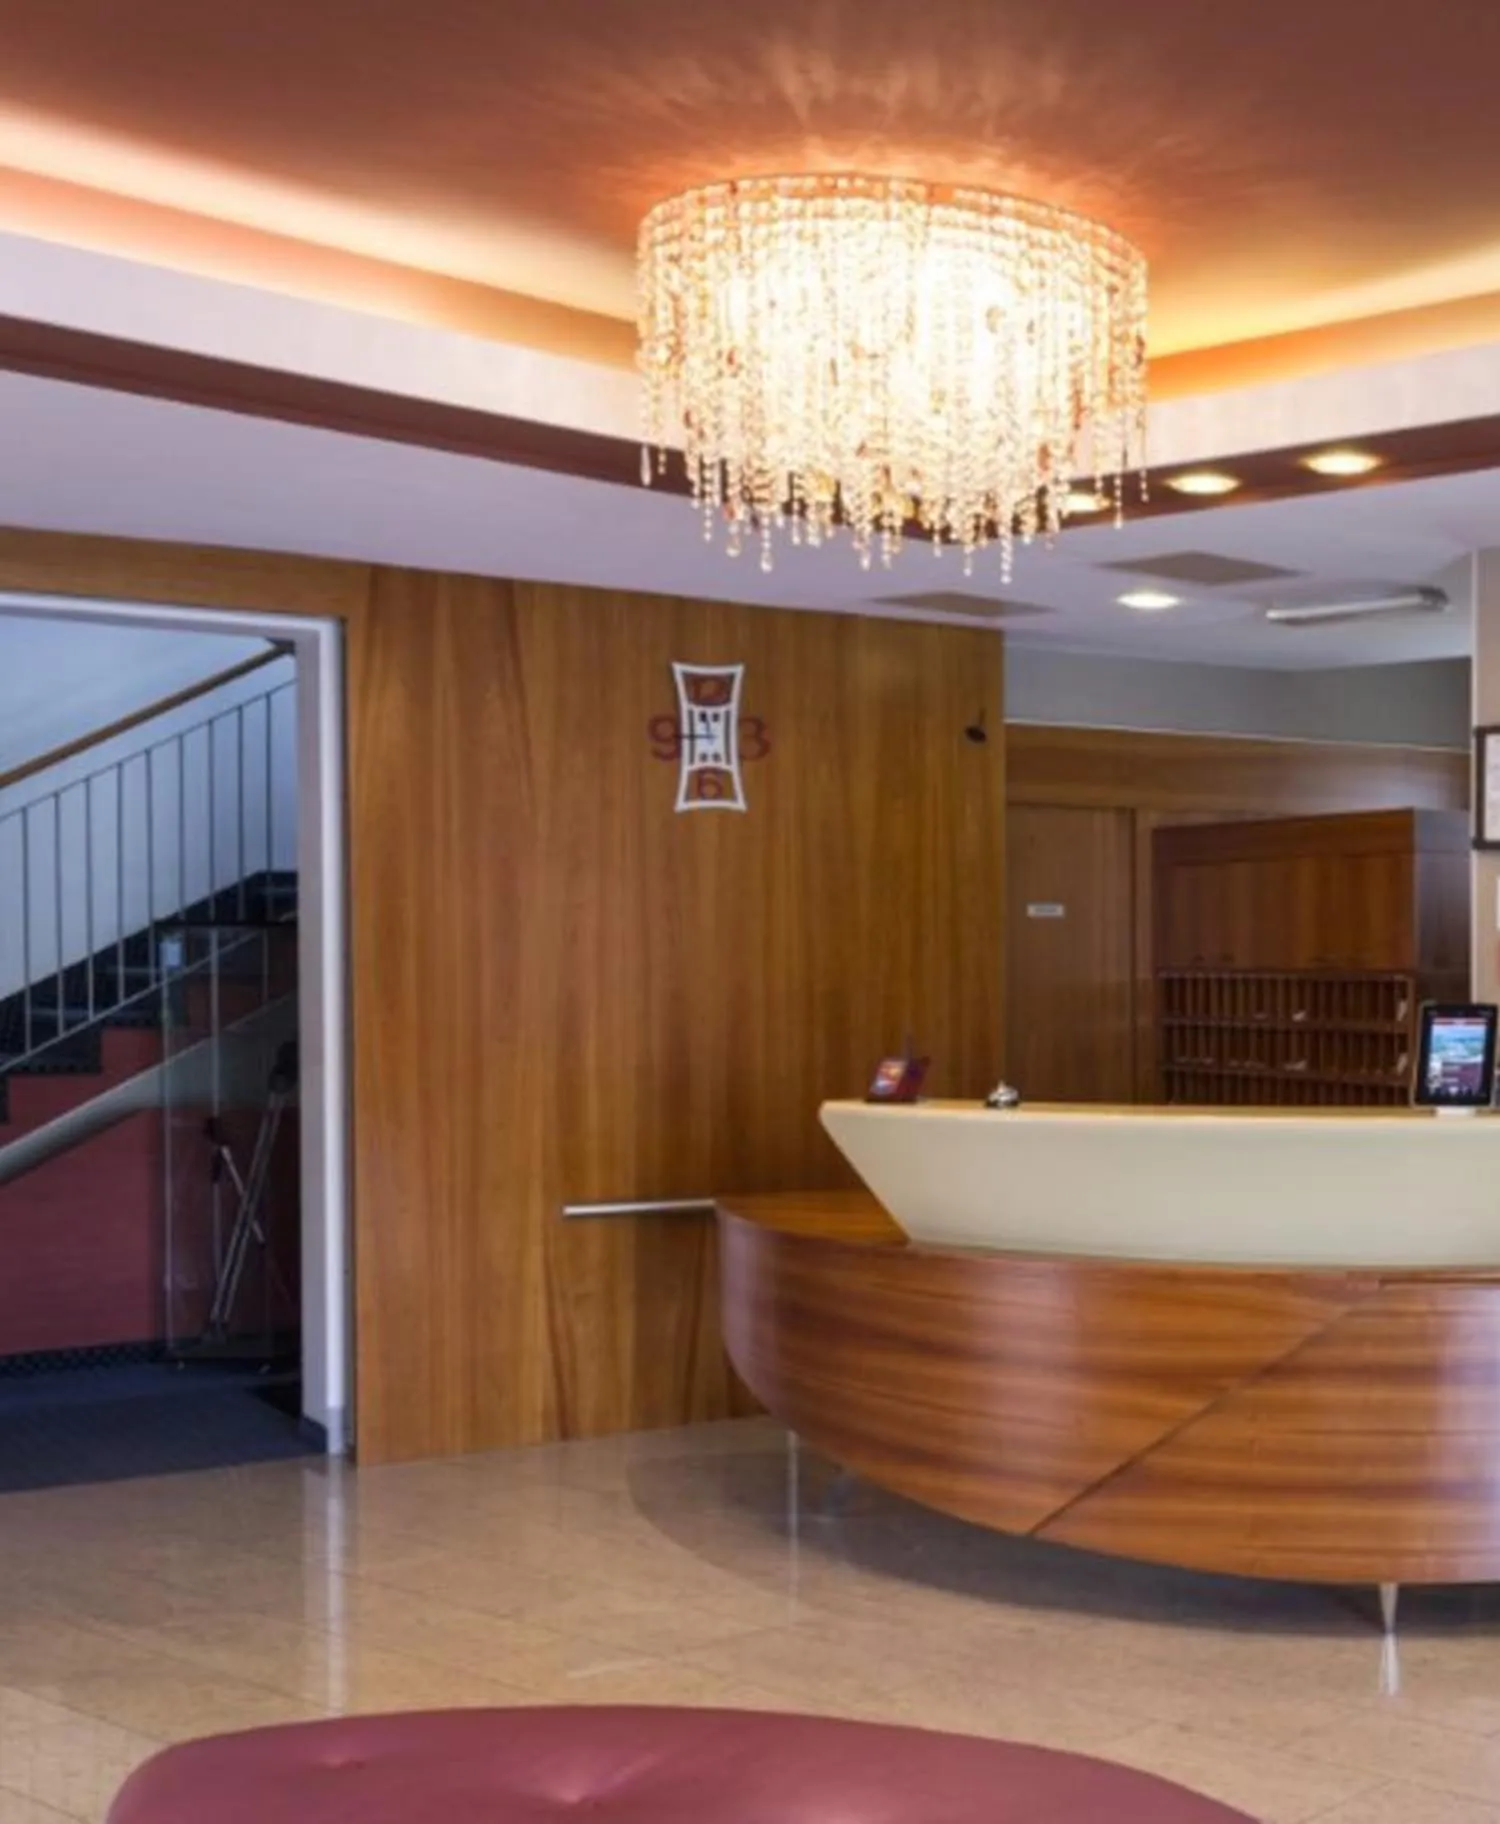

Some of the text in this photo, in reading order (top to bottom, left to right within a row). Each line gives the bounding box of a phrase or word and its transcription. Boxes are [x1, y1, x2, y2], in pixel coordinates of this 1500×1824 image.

[649, 714, 682, 761] 9
[738, 715, 771, 761] 3
[697, 768, 724, 801] 6
